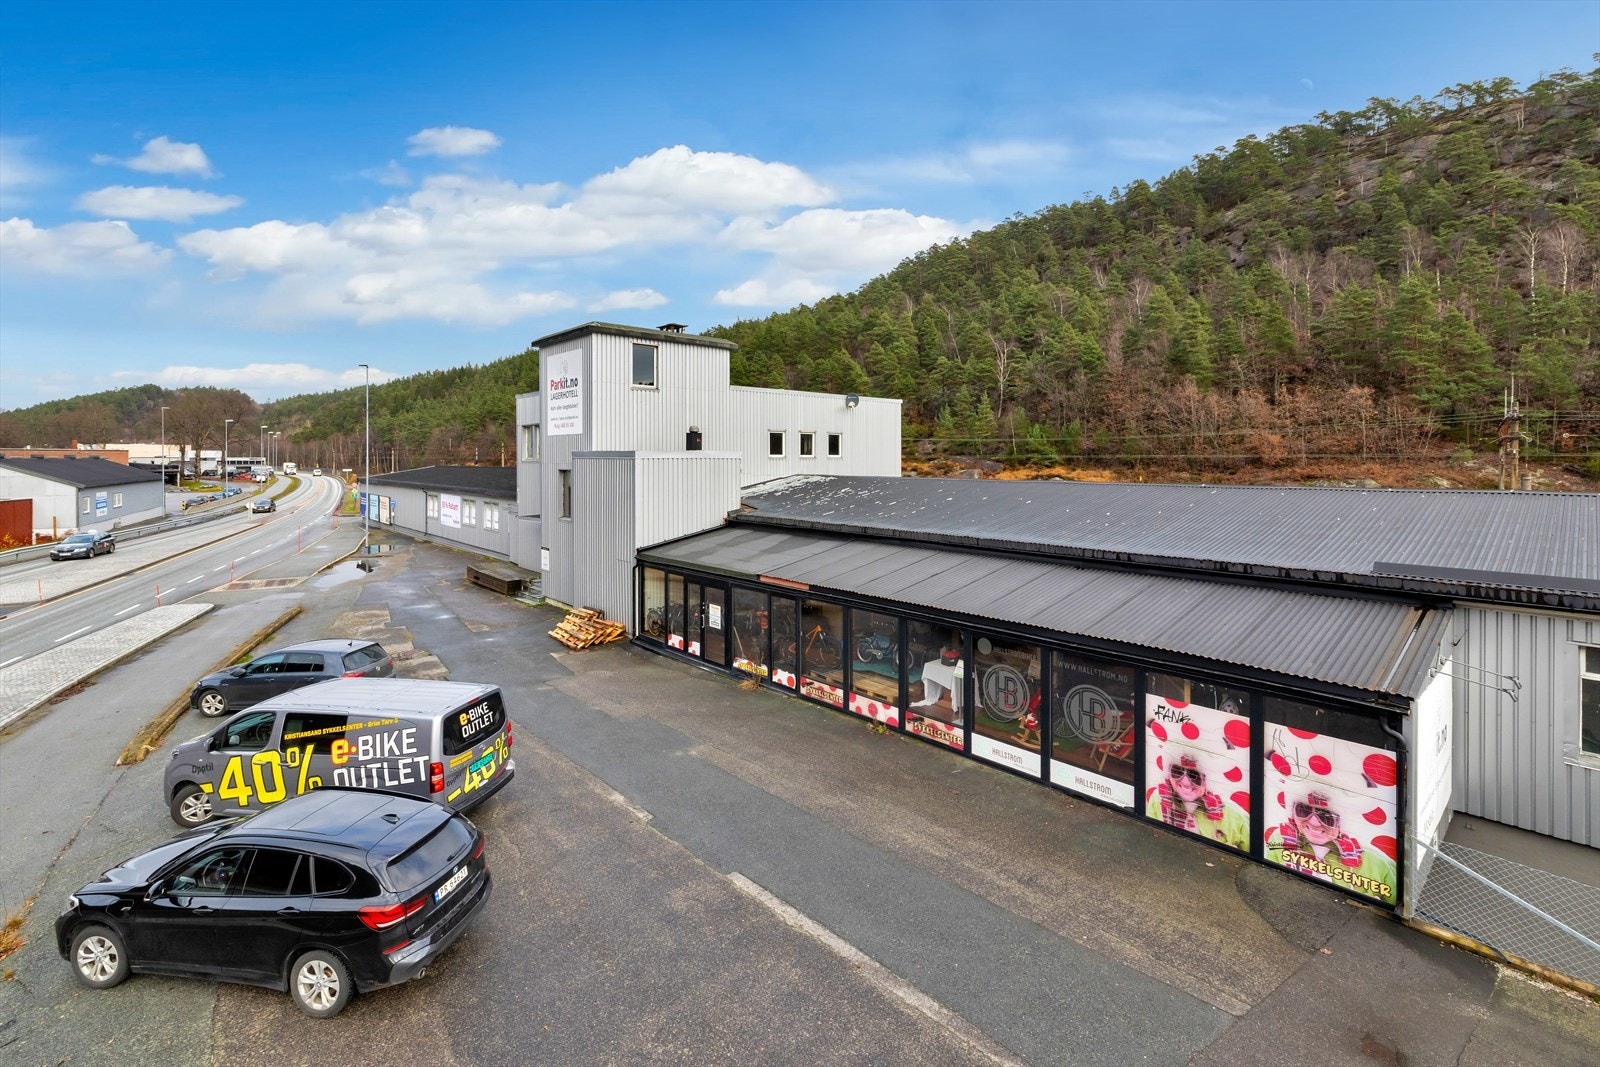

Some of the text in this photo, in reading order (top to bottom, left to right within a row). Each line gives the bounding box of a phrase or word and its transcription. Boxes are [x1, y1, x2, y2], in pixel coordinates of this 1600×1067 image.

[550, 377, 579, 391] Parkit.no
[550, 390, 579, 401] LAGERHOTELL
[284, 728, 322, 741] KRISTIANSAND
[322, 722, 363, 735] SYKKELSENTER
[367, 720, 381, 728] Grim
[461, 711, 494, 738] OUTLET
[913, 722, 963, 746] SYKKELSENTER
[992, 747, 1023, 764] HALLSTROM
[191, 763, 214, 775] Opptil
[333, 755, 430, 789] OUTLET
[1074, 776, 1112, 796] HALLSTROM
[1281, 849, 1392, 898] SYKKELSENTER
[439, 884, 449, 897] PR
